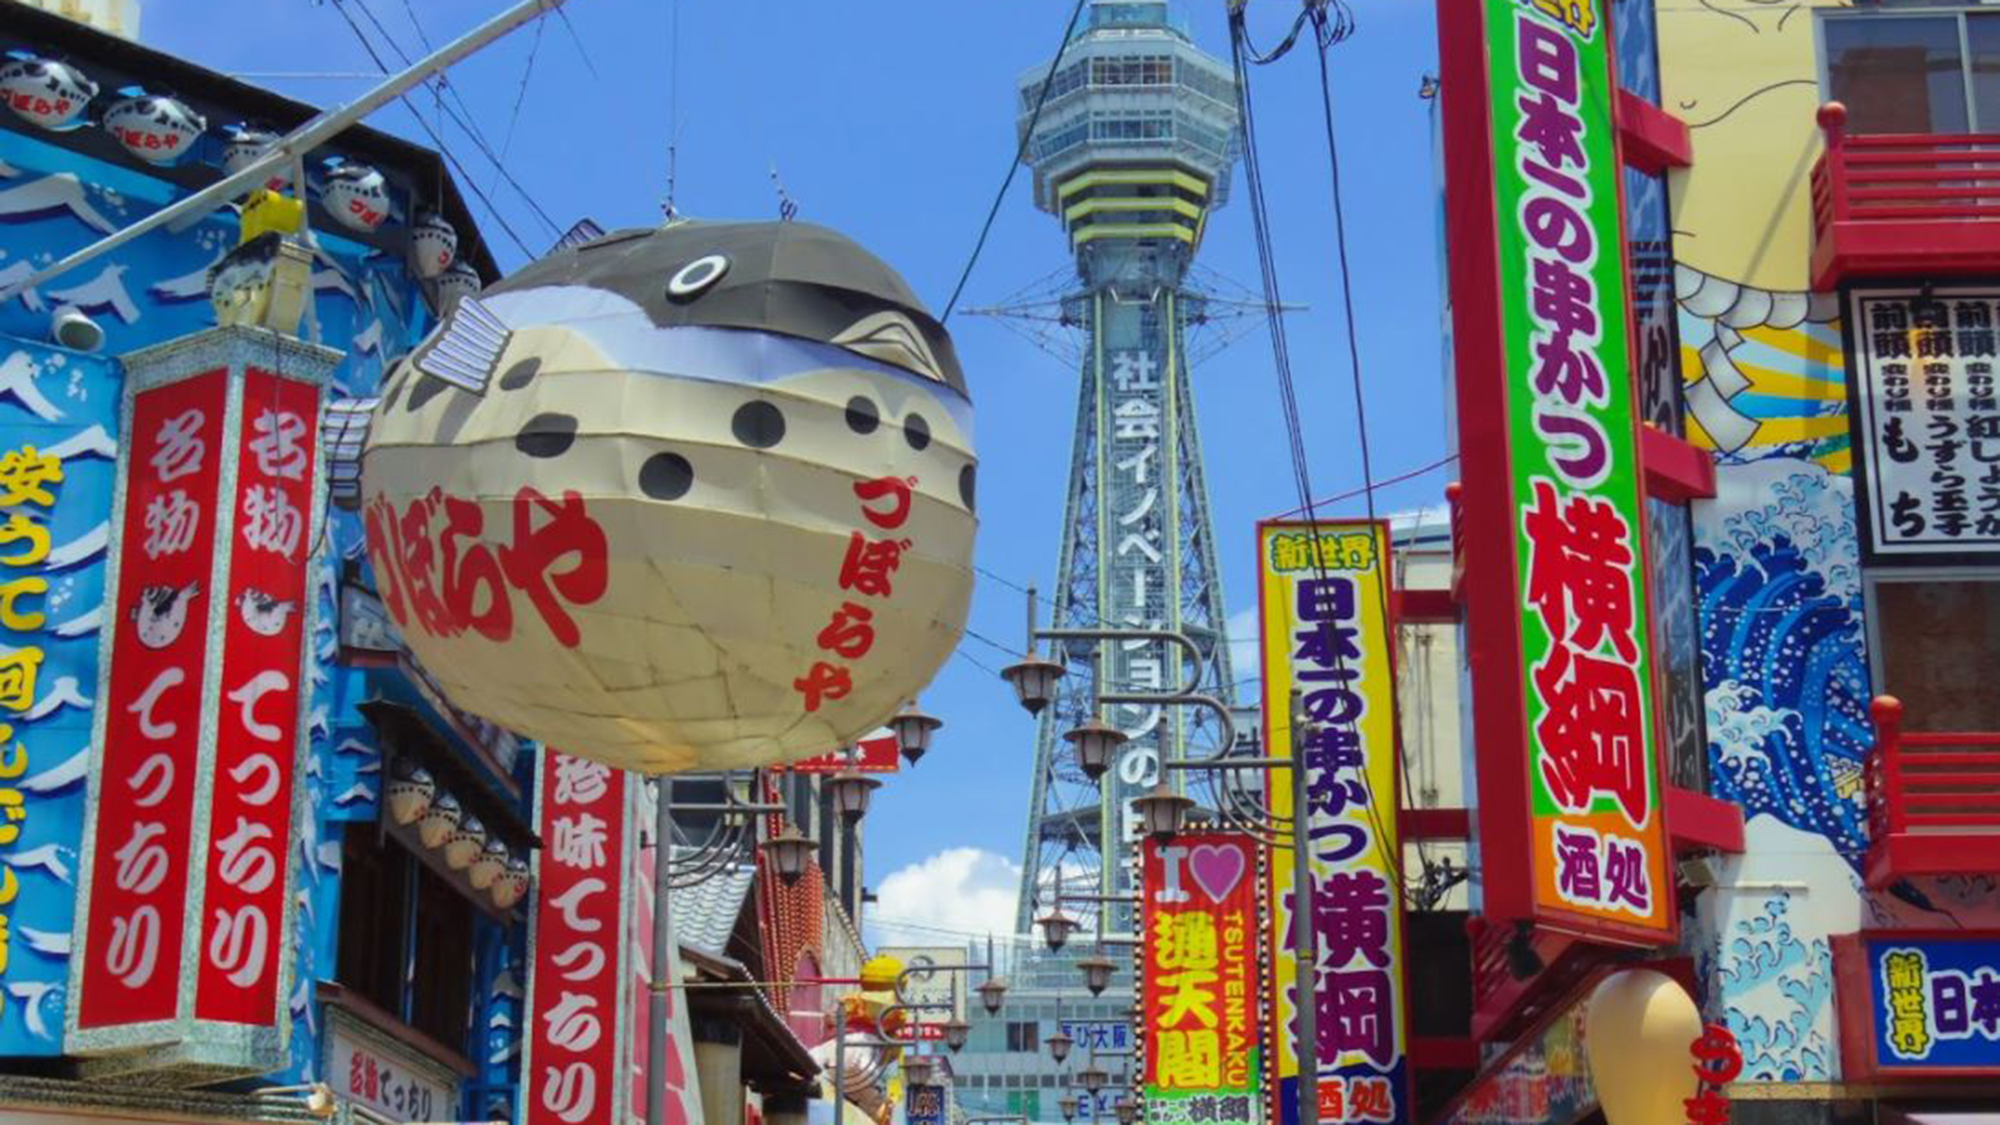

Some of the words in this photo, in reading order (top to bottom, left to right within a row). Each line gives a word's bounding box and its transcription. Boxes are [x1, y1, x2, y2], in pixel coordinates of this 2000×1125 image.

[143, 408, 207, 560] 名物
[242, 406, 309, 564] 名物
[1272, 533, 1378, 570] 新世界
[105, 666, 187, 989] てっちり
[208, 669, 290, 989] てっちり
[1555, 828, 1649, 912] 酒処
[542, 752, 613, 1124] 珍味てっちり
[1154, 911, 1219, 1089] 通天閣
[1224, 910, 1249, 1086] TSUTENKAKU
[1887, 952, 1930, 1055] 新世界
